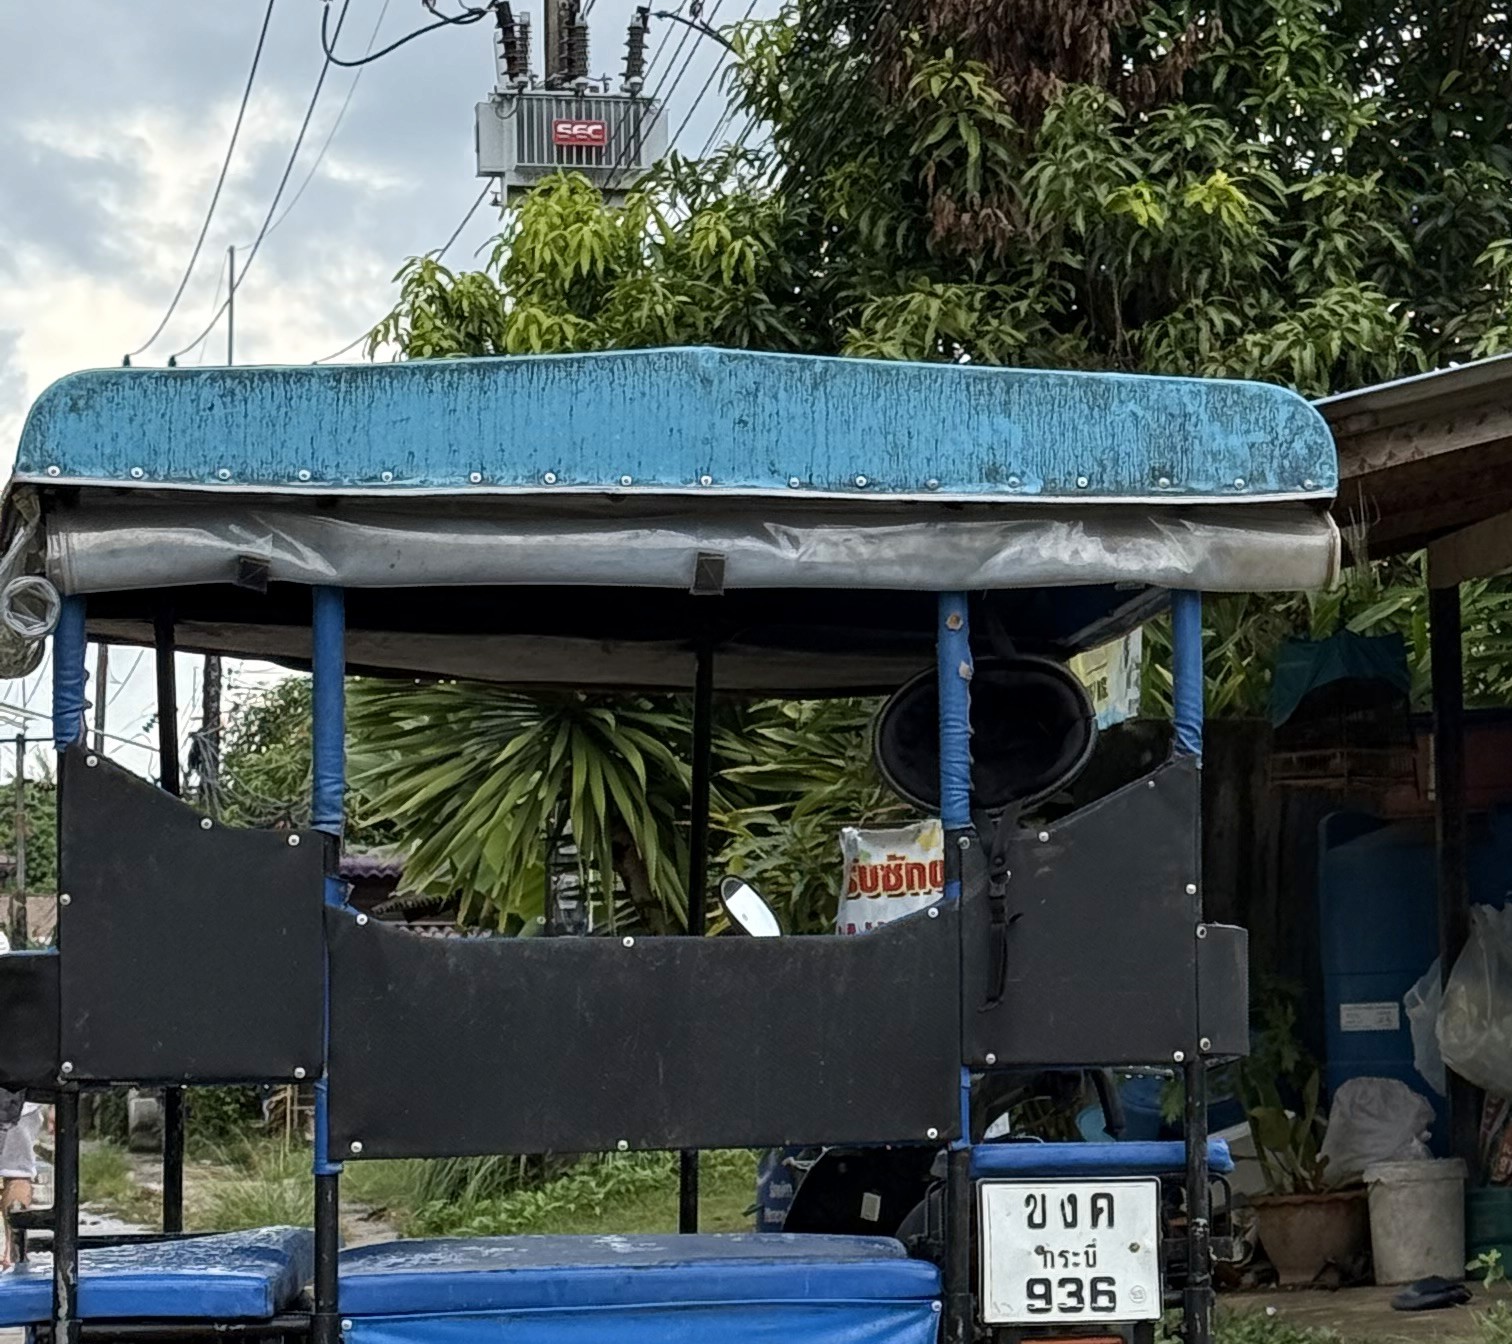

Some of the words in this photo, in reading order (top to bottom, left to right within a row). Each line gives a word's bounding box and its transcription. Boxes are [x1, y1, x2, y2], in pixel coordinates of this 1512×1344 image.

[1024, 1192, 1115, 1230] ขงค
[1041, 1237, 1098, 1269] กระบี่
[1026, 1276, 1117, 1314] 936
